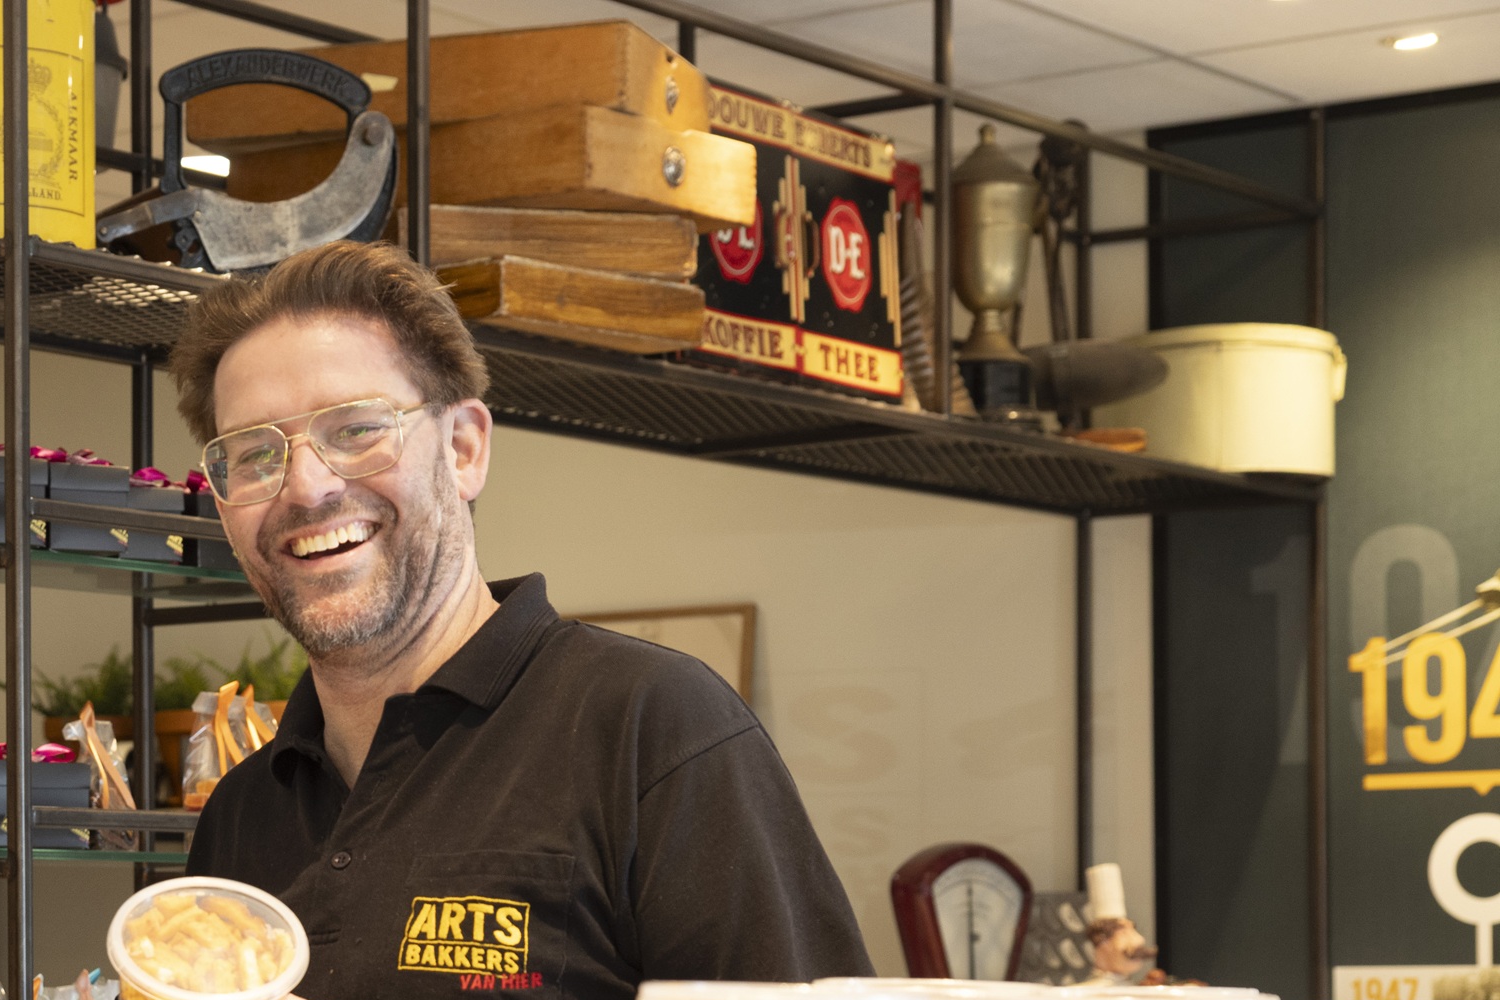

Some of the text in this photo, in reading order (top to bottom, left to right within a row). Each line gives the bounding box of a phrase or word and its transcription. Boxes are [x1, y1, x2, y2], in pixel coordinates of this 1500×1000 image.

[819, 343, 880, 382] THEE
[408, 902, 523, 946] ARTS
[405, 944, 519, 974] BAKKERS
[460, 972, 543, 990] VAN HIER
